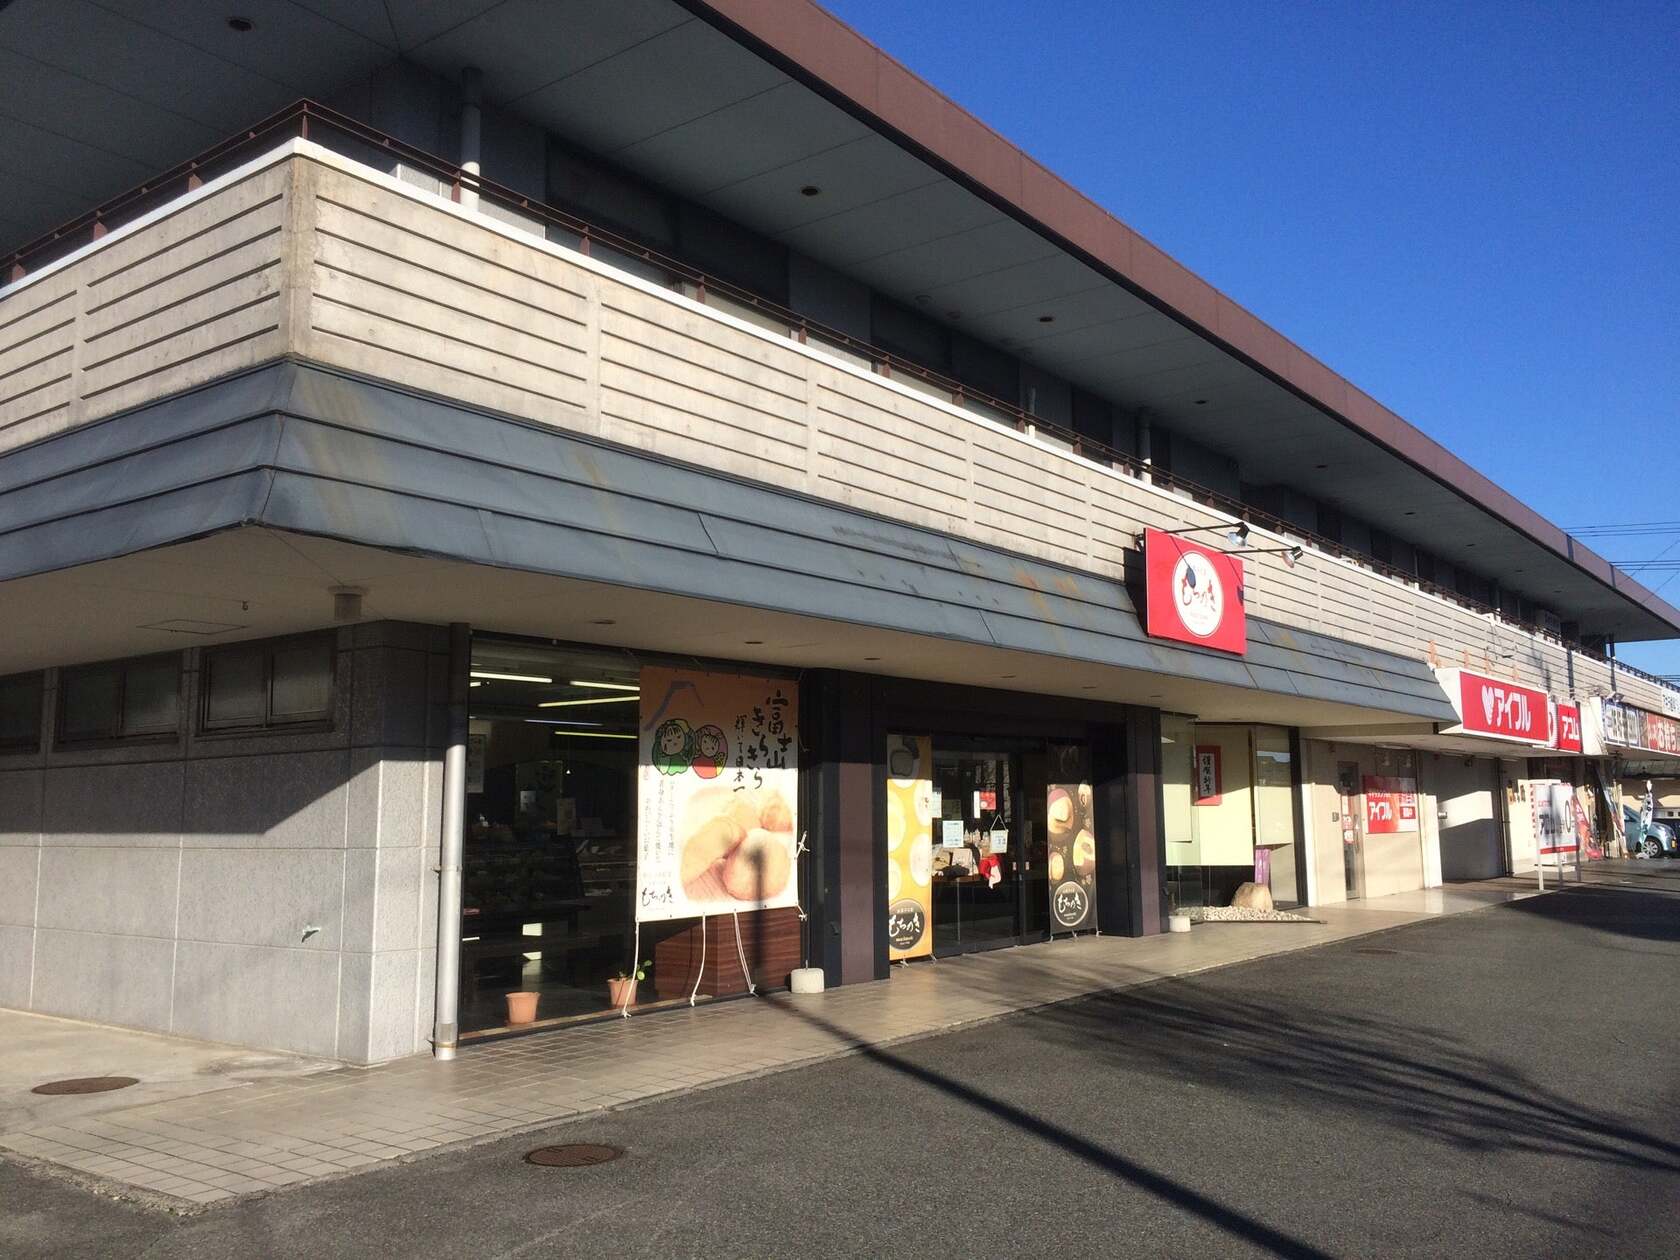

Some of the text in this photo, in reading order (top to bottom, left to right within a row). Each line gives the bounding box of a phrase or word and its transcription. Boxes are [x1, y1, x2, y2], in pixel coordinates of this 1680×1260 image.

[766, 688, 792, 769] 富士山
[1493, 688, 1532, 732] アイフル
[1561, 715, 1580, 741] アコム
